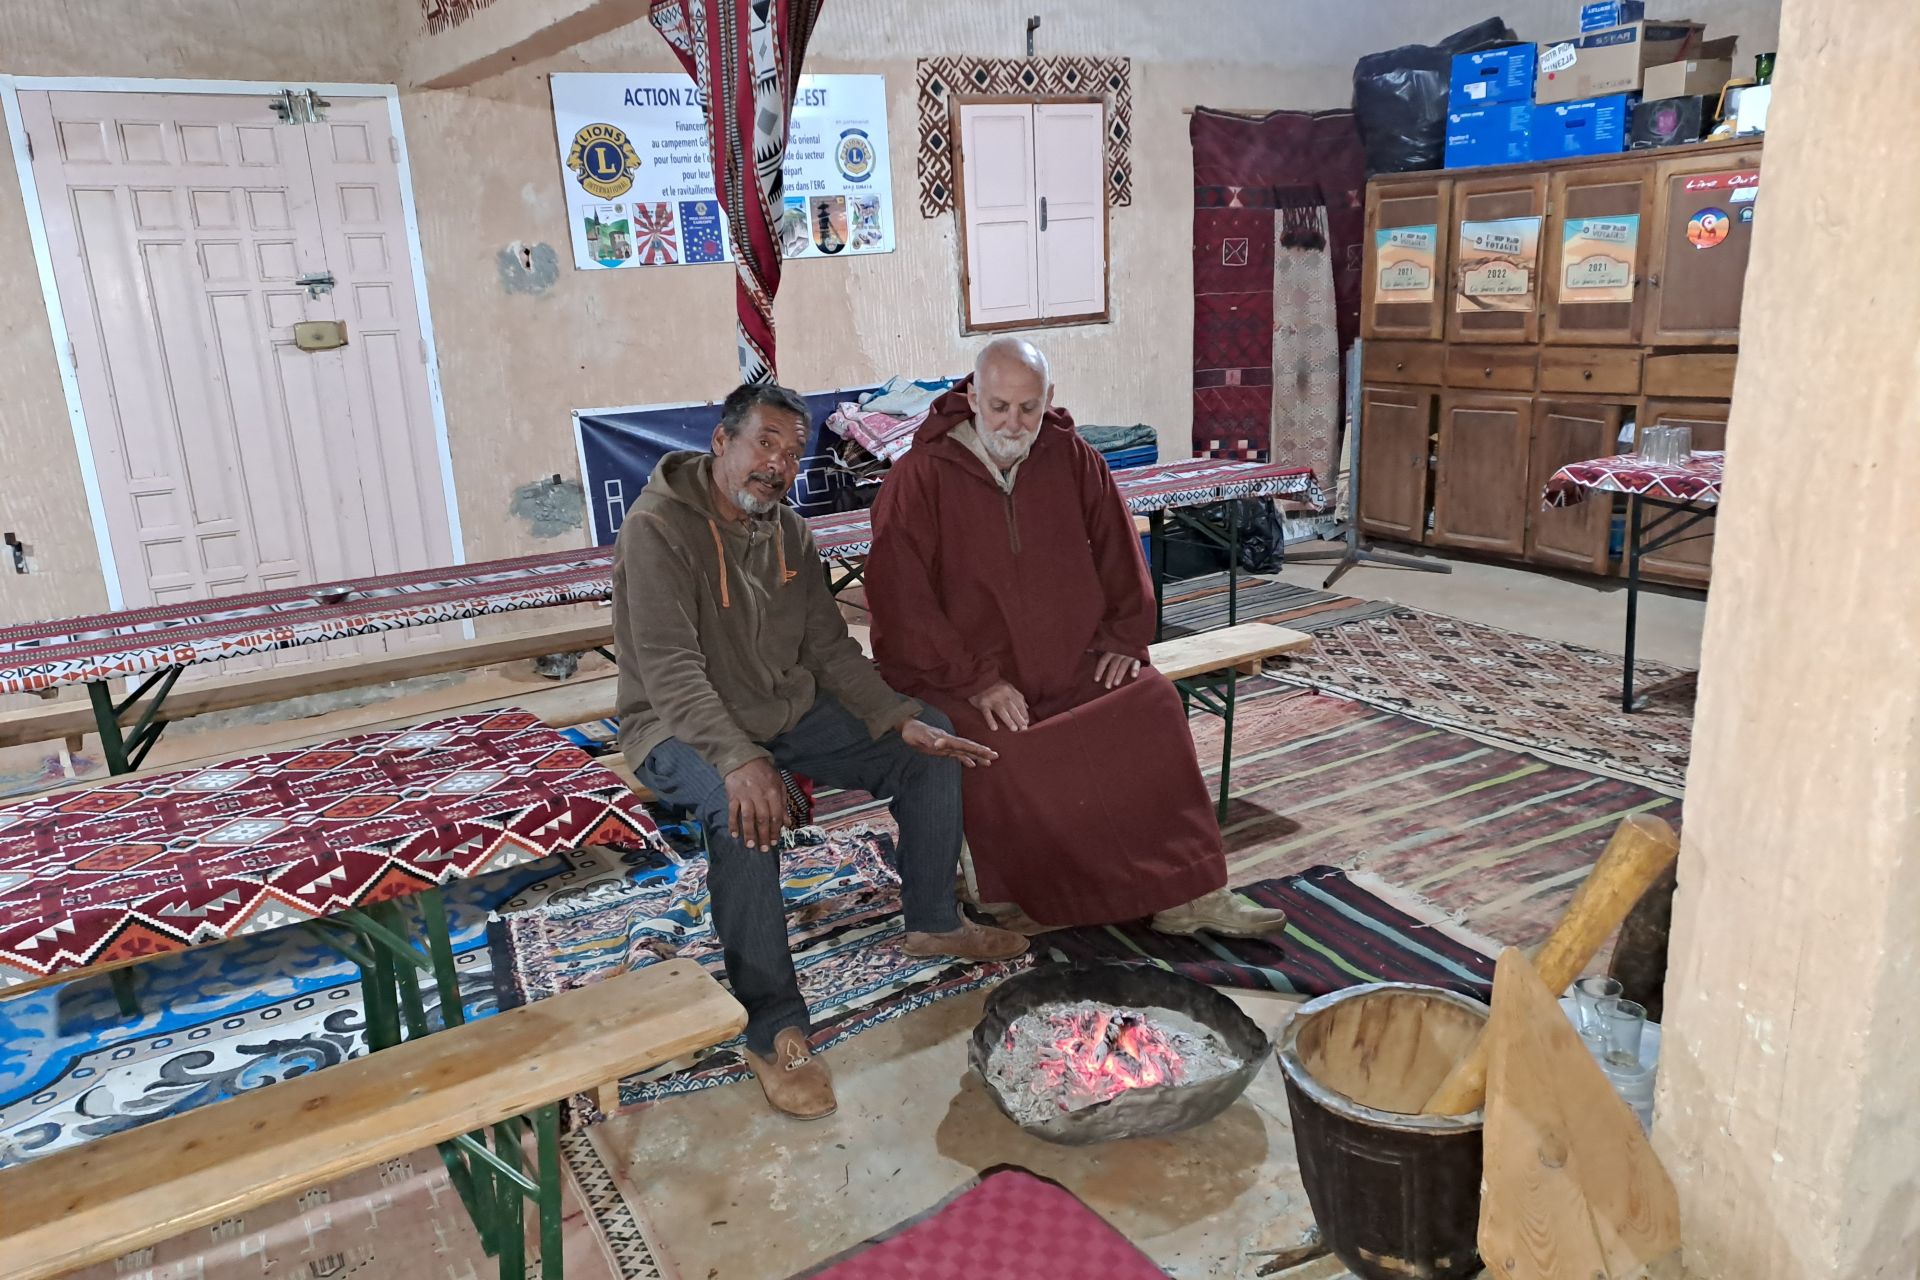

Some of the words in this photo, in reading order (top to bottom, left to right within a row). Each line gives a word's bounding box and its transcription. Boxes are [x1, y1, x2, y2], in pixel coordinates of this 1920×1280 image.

[624, 88, 681, 106] ACTION
[685, 88, 702, 106] ZO
[793, 89, 827, 106] -EST
[579, 126, 622, 143] LIONS
[675, 121, 706, 132] Financem
[651, 140, 660, 149] au
[661, 138, 698, 151] campement
[798, 134, 820, 145] oriental
[594, 147, 617, 174] L
[653, 156, 669, 167] pour
[670, 153, 692, 164] fournir
[693, 153, 702, 164] de
[795, 150, 804, 160] du
[804, 151, 825, 160] secteur
[682, 171, 697, 182] pour
[698, 169, 711, 179] leur
[662, 187, 669, 197] et
[670, 185, 676, 196] le
[677, 184, 716, 196] ravitailleme
[796, 181, 809, 191] dans
[1487, 269, 1507, 279] 2022
[1588, 263, 1607, 272] 2021
